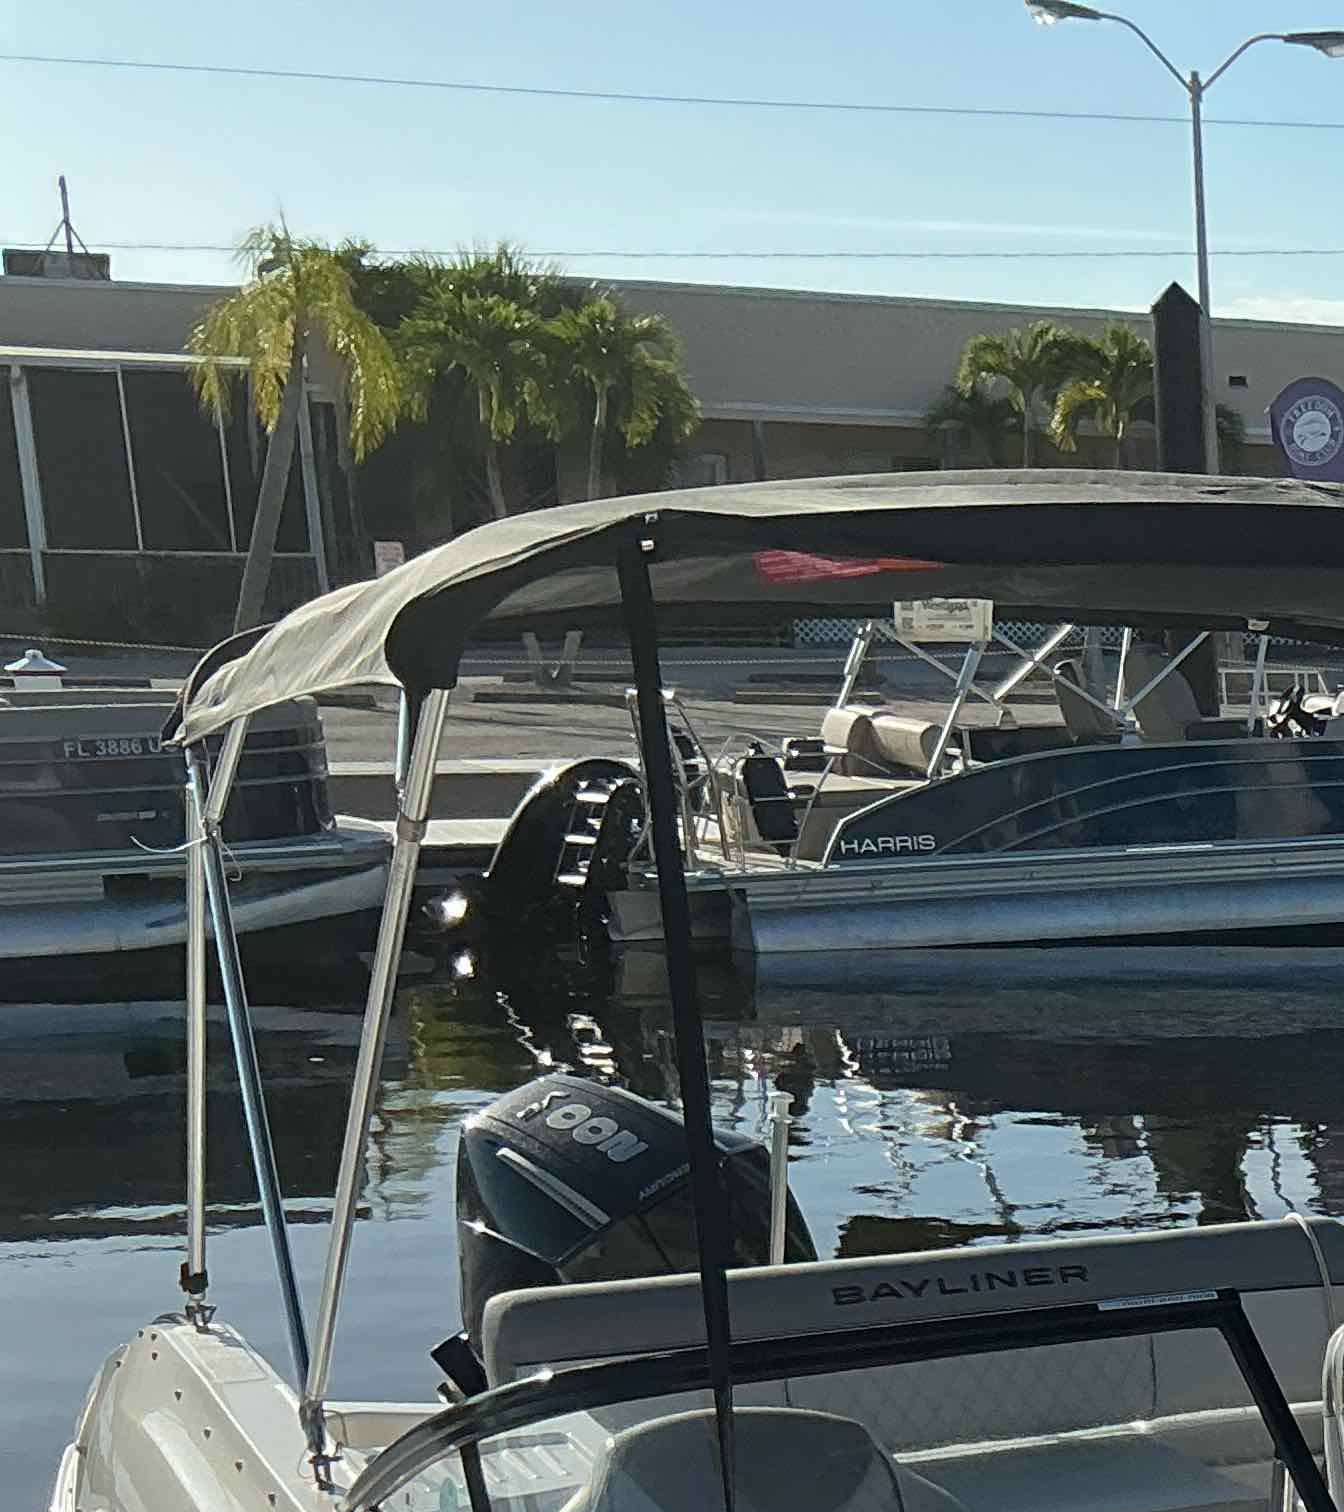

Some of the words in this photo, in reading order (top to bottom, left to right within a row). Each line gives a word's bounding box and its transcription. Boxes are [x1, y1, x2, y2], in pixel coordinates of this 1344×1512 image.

[63, 741, 91, 758] FL
[95, 738, 143, 756] 3886
[840, 834, 936, 855] HARRIS
[831, 1265, 1090, 1306] BAYLINER
